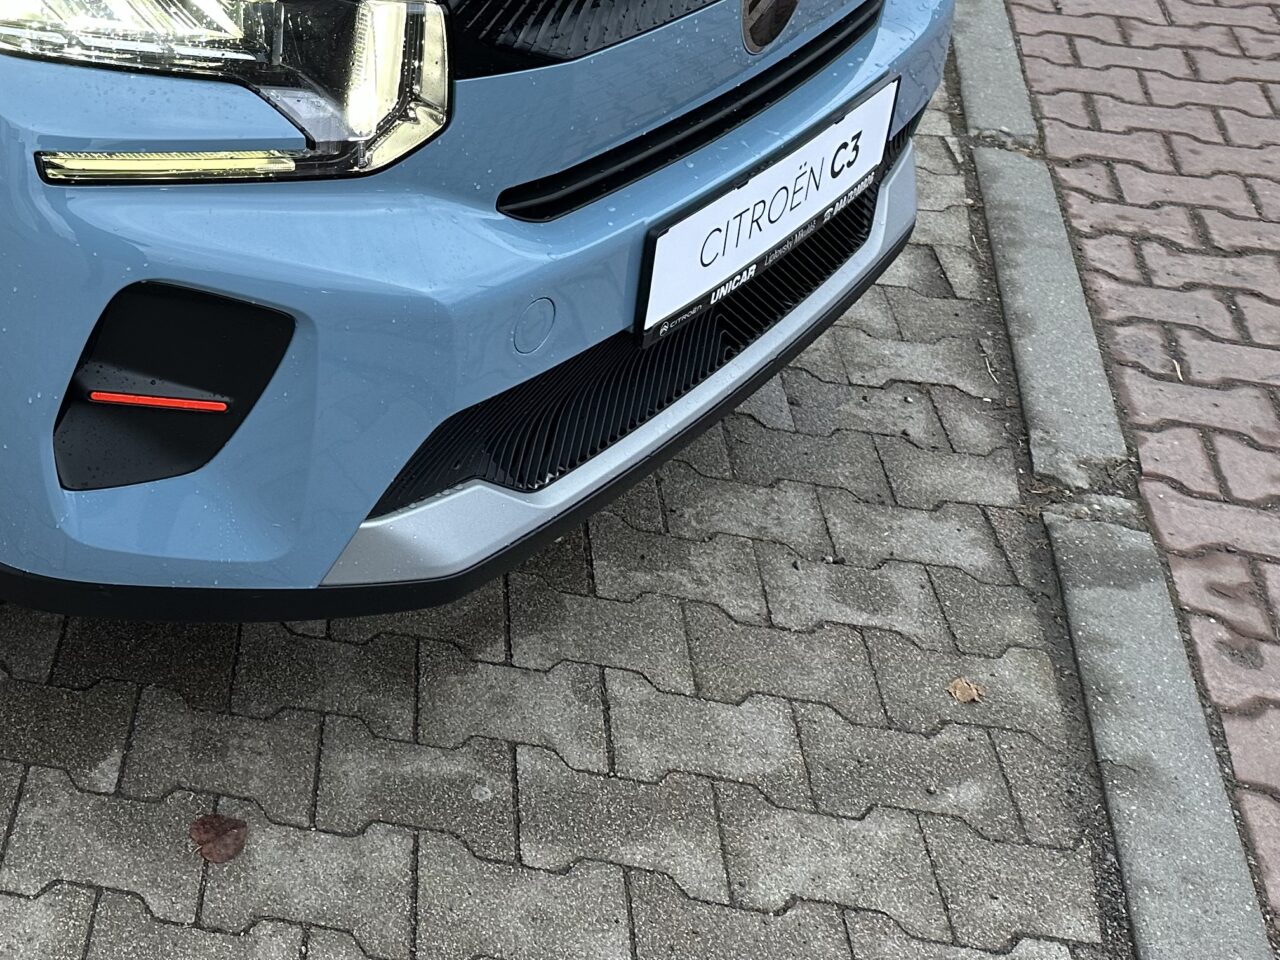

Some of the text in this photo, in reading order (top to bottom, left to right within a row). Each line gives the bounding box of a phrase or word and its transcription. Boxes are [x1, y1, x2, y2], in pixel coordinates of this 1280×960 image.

[699, 156, 825, 268] CITROËN
[829, 130, 863, 179] C3
[709, 263, 757, 306] UNICAR
